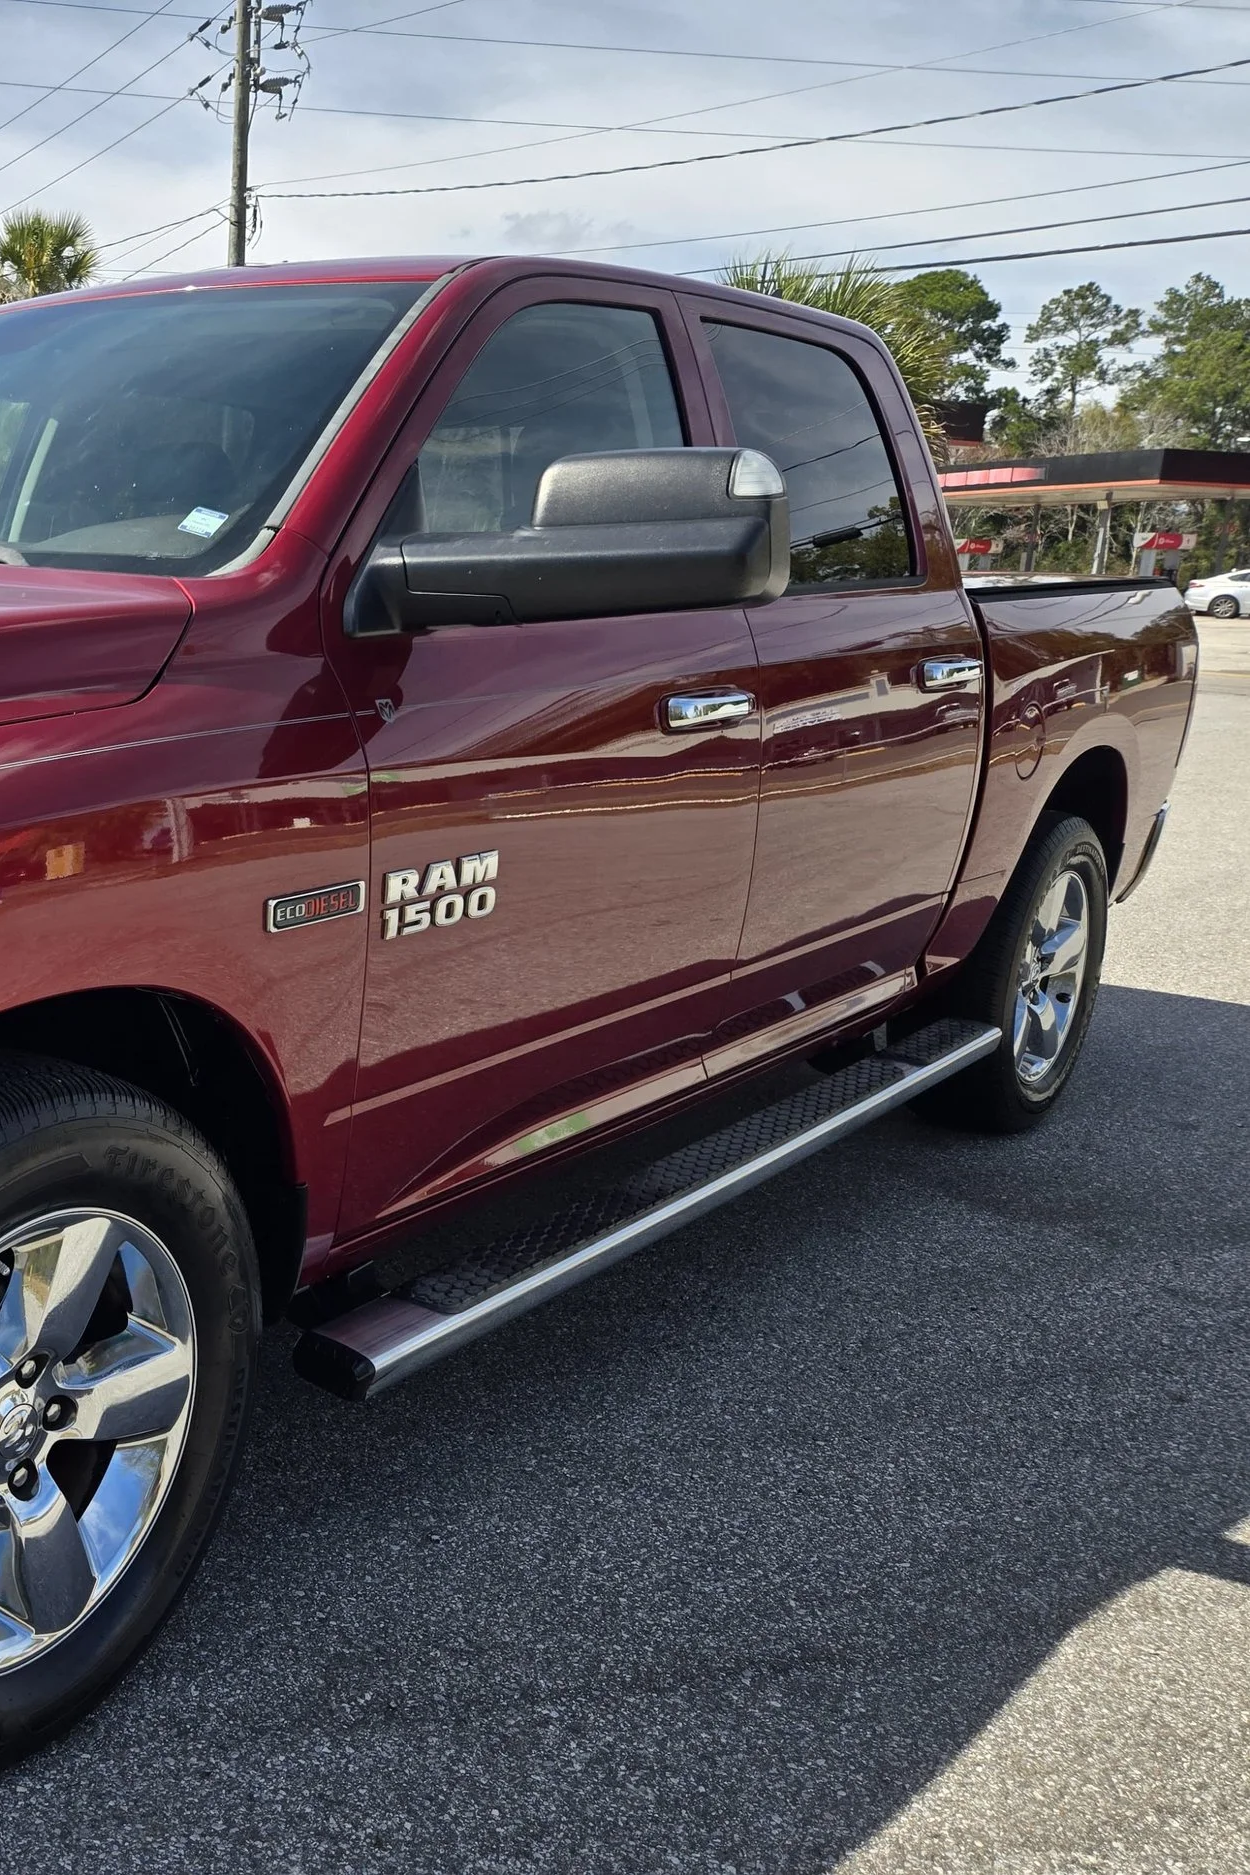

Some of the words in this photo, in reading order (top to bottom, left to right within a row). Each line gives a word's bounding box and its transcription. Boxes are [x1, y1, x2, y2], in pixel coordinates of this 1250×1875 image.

[384, 850, 499, 904] RAM
[276, 887, 359, 922] ECODIESEL
[382, 886, 496, 940] 1500
[104, 1144, 238, 1277] Firestone
